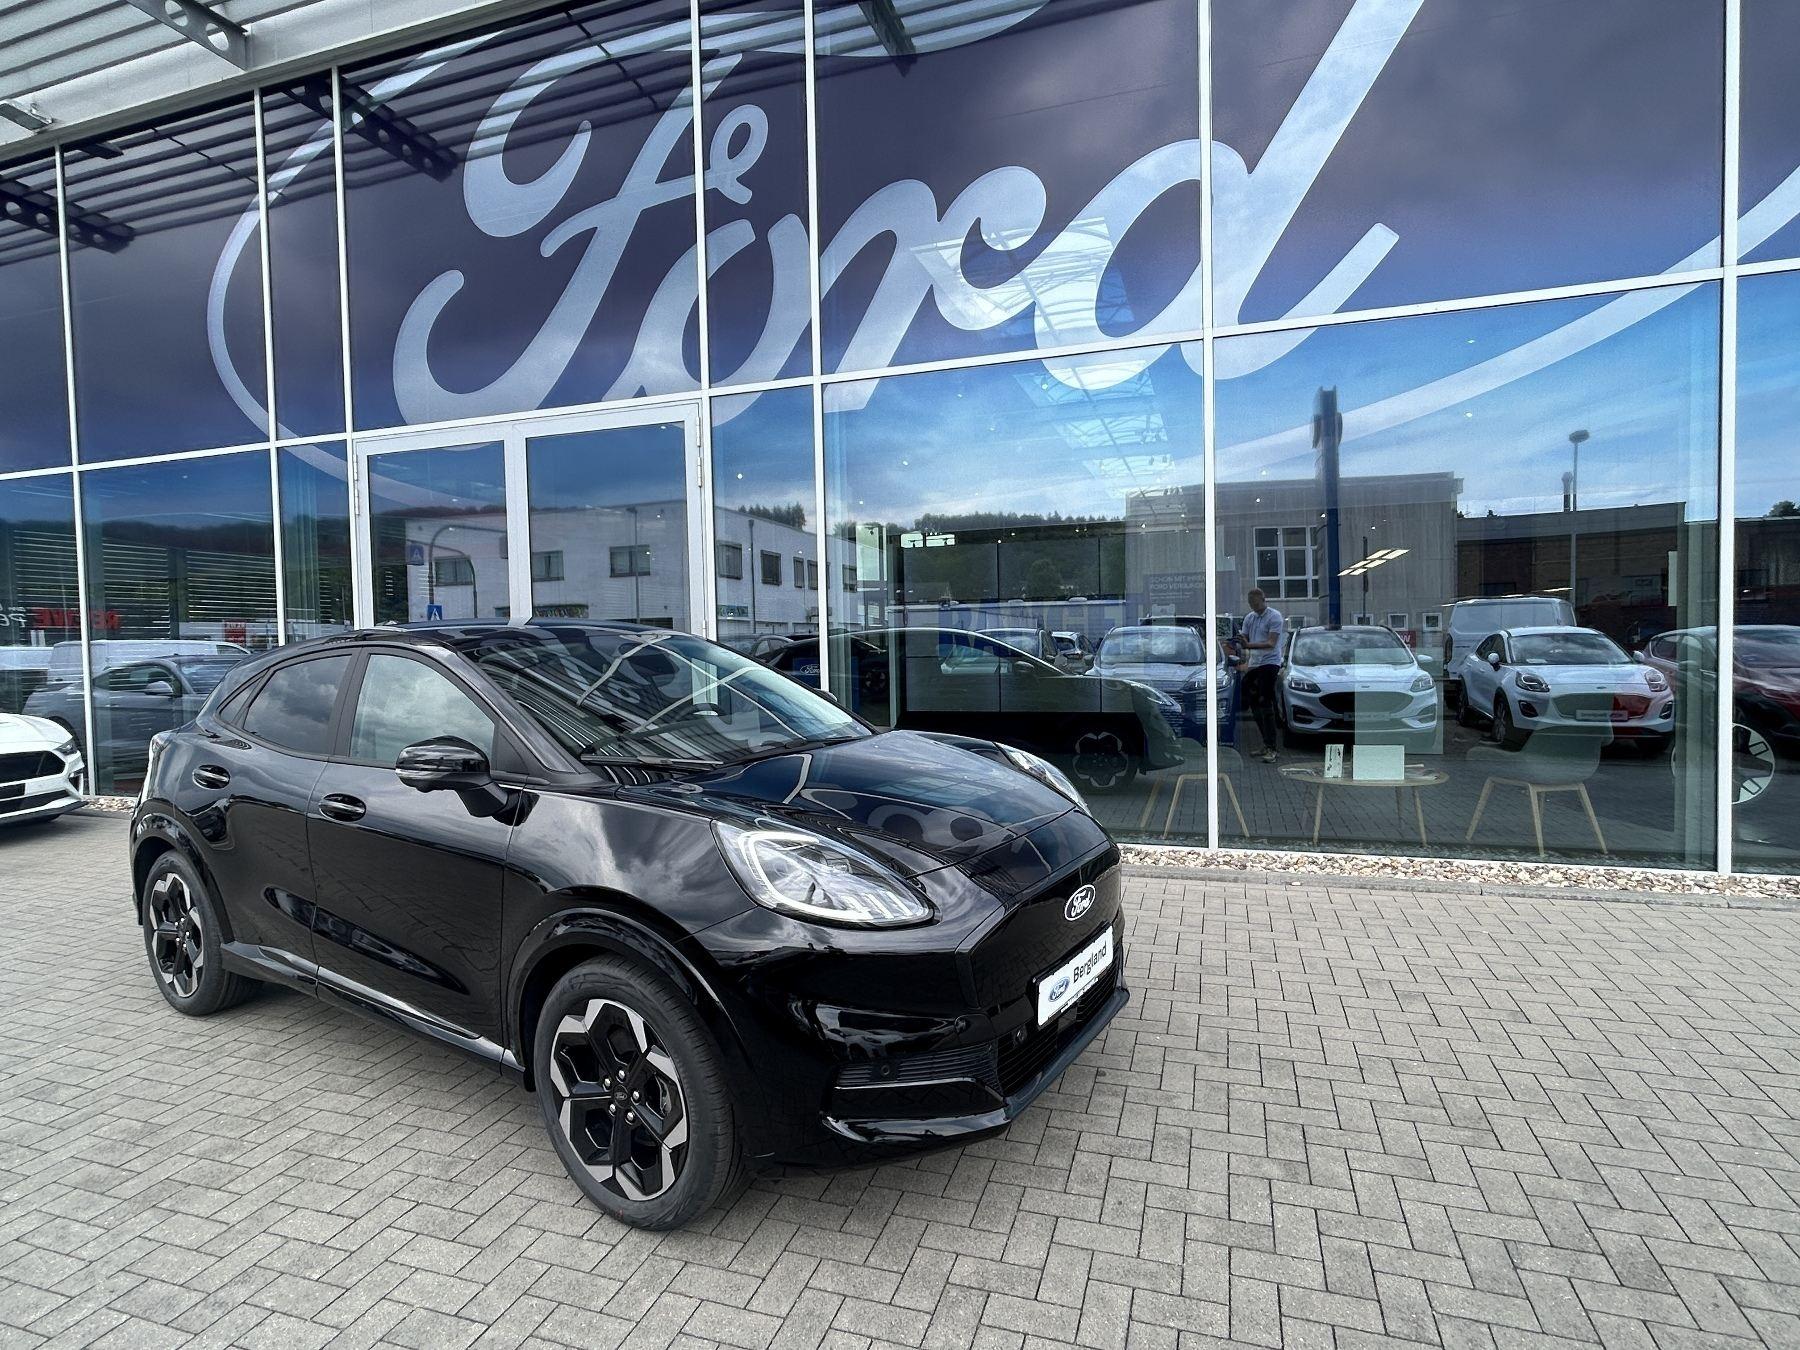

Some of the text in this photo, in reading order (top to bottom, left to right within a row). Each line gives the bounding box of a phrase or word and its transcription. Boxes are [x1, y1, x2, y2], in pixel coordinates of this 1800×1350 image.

[390, 0, 1418, 450] Ford
[1069, 888, 1092, 918] Ford
[1073, 940, 1107, 983] Bergland
